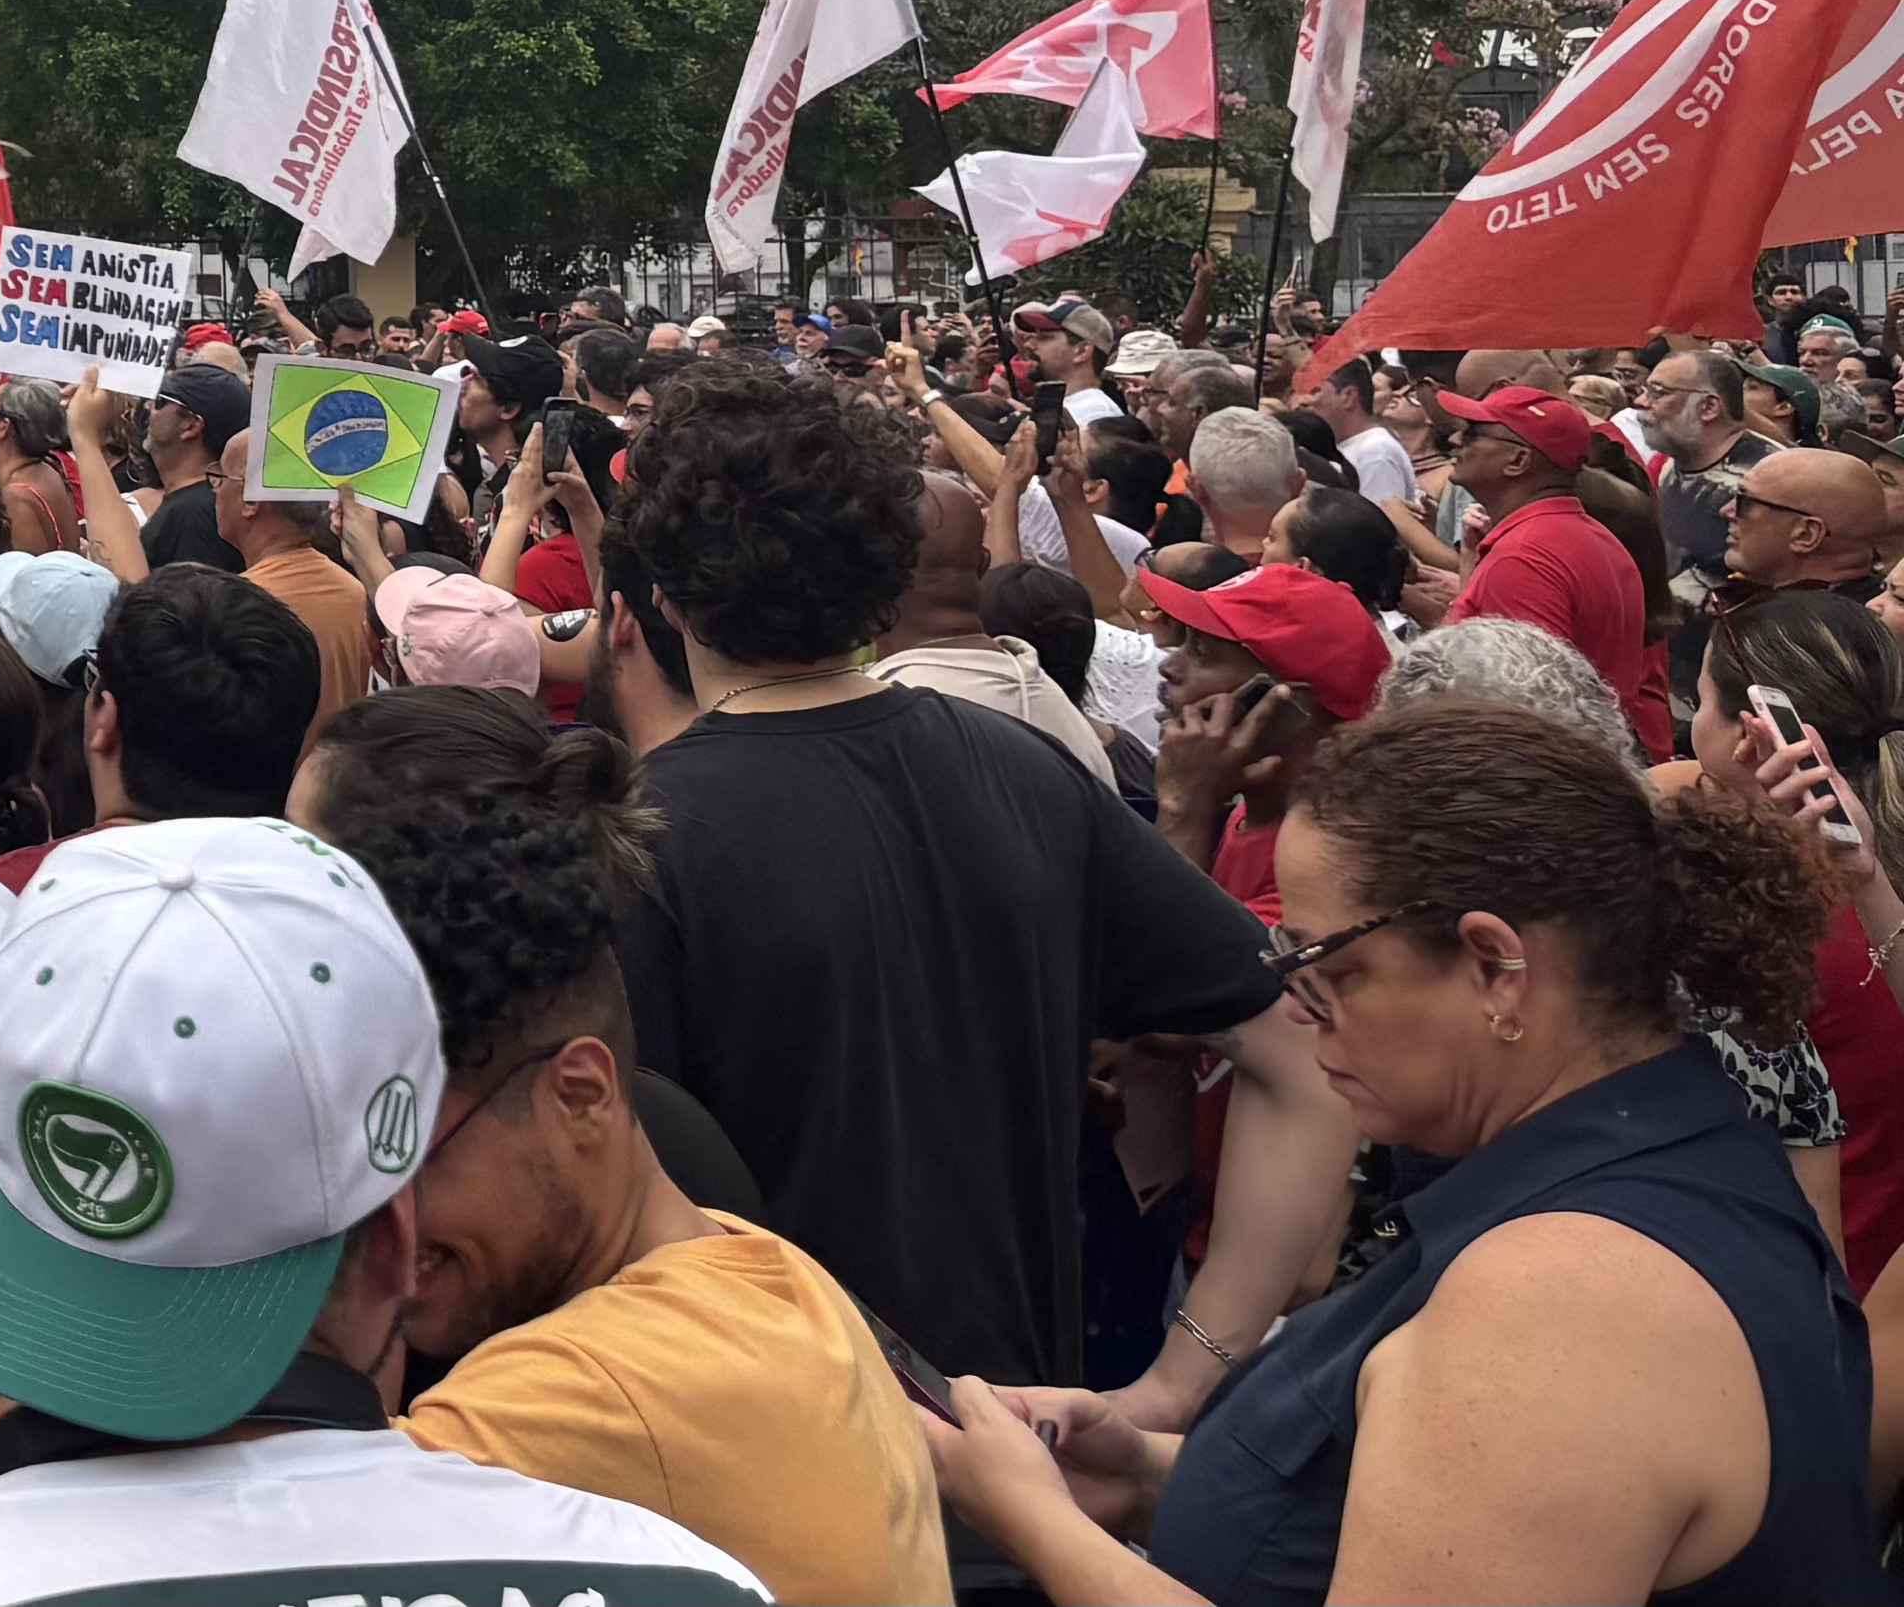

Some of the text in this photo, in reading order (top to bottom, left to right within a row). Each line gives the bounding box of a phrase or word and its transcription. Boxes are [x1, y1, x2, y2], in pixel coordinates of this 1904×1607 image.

[1588, 132, 1671, 201] SEM
[1485, 190, 1578, 234] TETO
[5, 234, 74, 272] SEM
[0, 269, 68, 309] SEM
